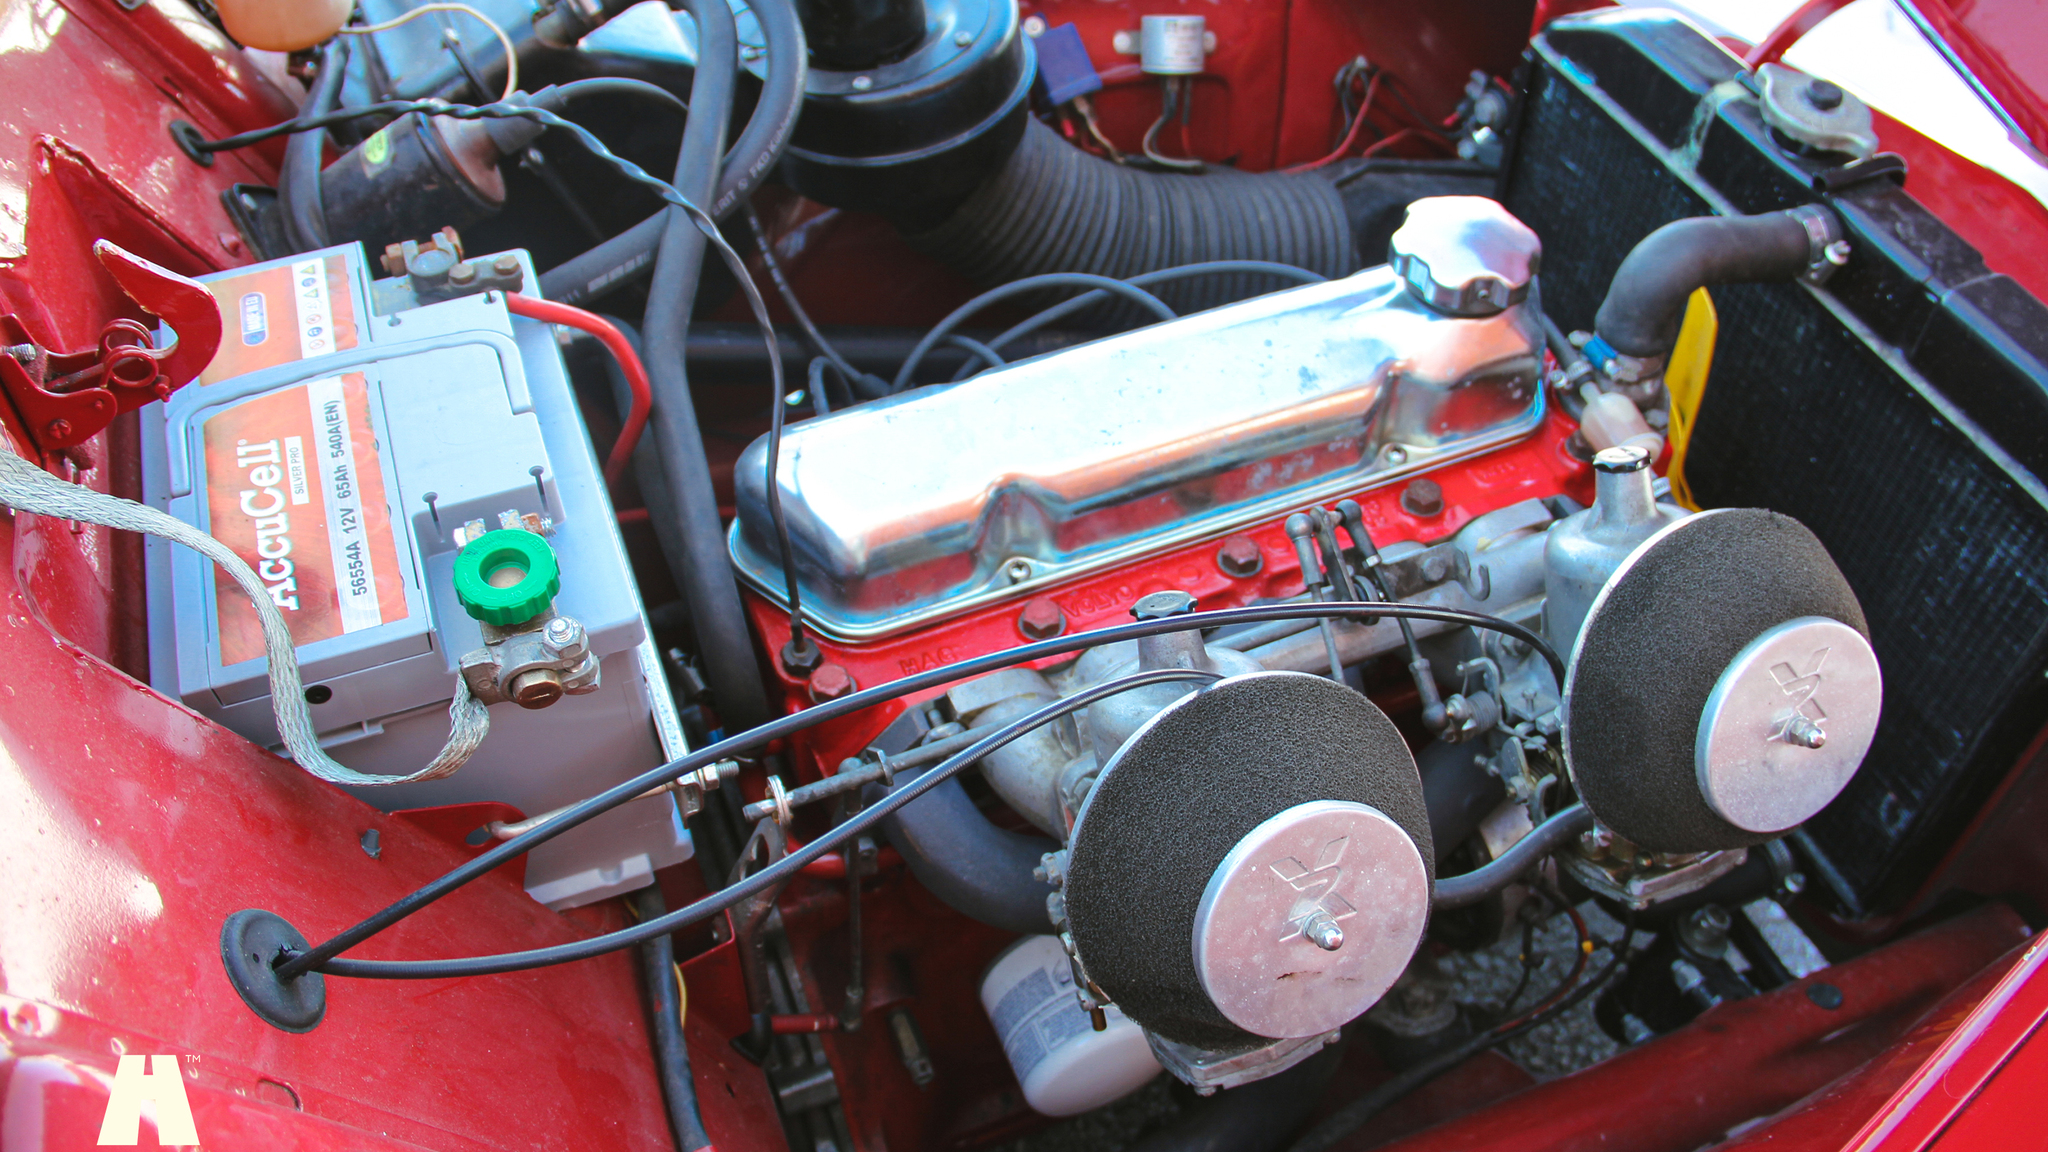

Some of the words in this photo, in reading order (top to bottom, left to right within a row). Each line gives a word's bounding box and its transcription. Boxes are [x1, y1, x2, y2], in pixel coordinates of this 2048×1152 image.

[323, 400, 345, 460] 540A(EN)
[289, 446, 300, 459] PRO
[291, 461, 304, 495] SILVER
[331, 464, 351, 500] 65Ah
[339, 508, 358, 535] 12V
[345, 540, 368, 597] 56554A
